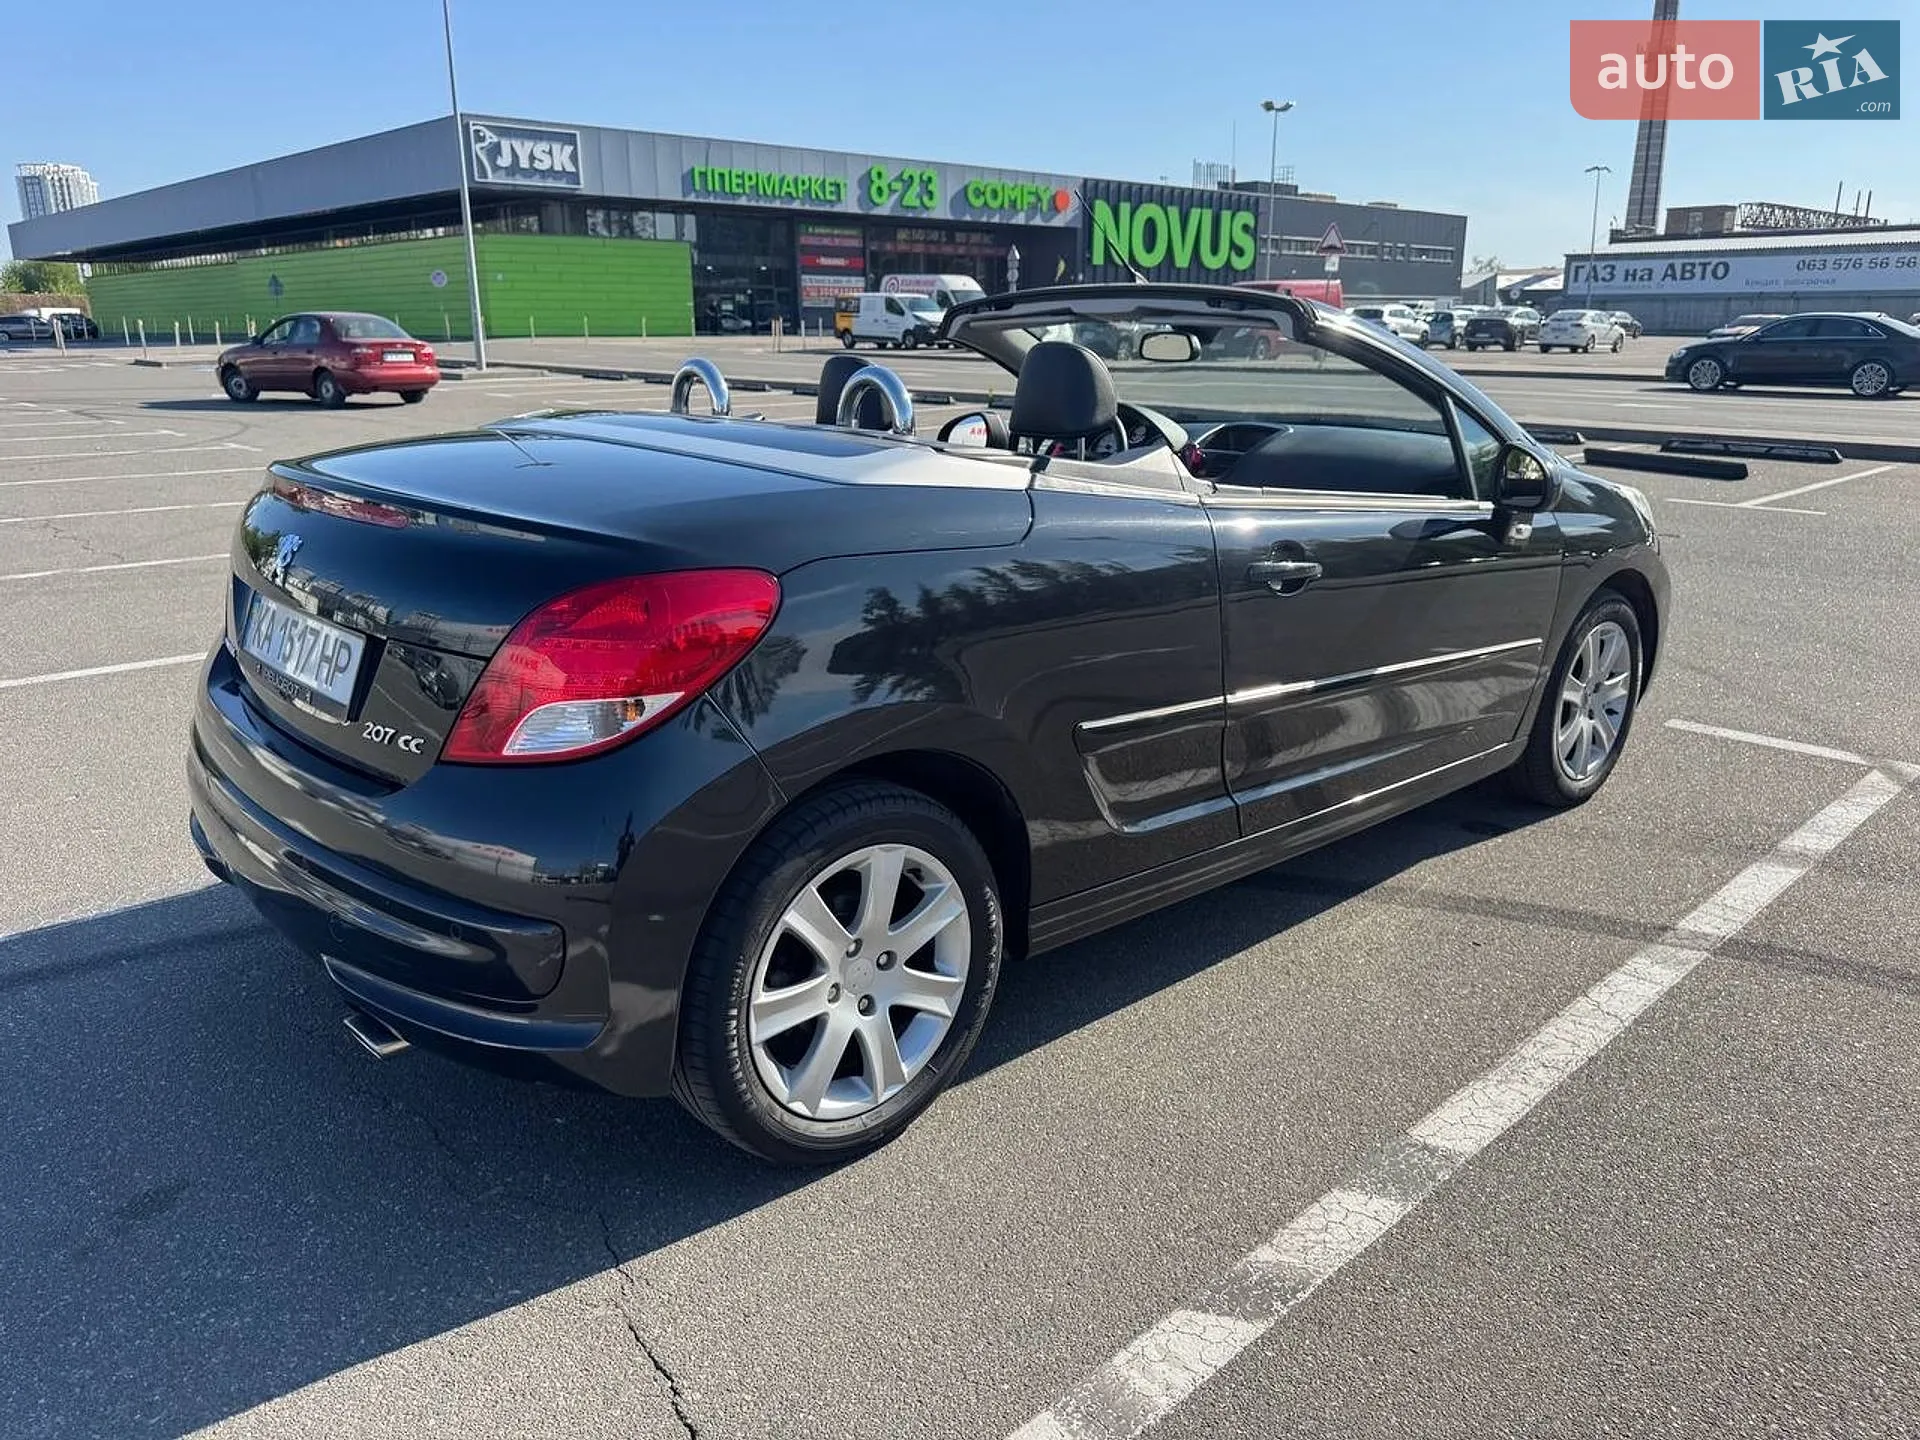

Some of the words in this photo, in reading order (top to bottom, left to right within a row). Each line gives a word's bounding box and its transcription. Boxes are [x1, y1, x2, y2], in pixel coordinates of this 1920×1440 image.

[495, 138, 577, 173] JYSK
[691, 165, 848, 201] ГІПЕРМАРКЕТ
[869, 164, 939, 212] 8-23
[966, 179, 1053, 213] COMFY
[1092, 199, 1256, 271] NOVUS
[1572, 263, 1617, 284] ГАЗ
[1623, 267, 1654, 282] на
[1661, 261, 1731, 282] АВТО
[362, 721, 397, 745] 207
